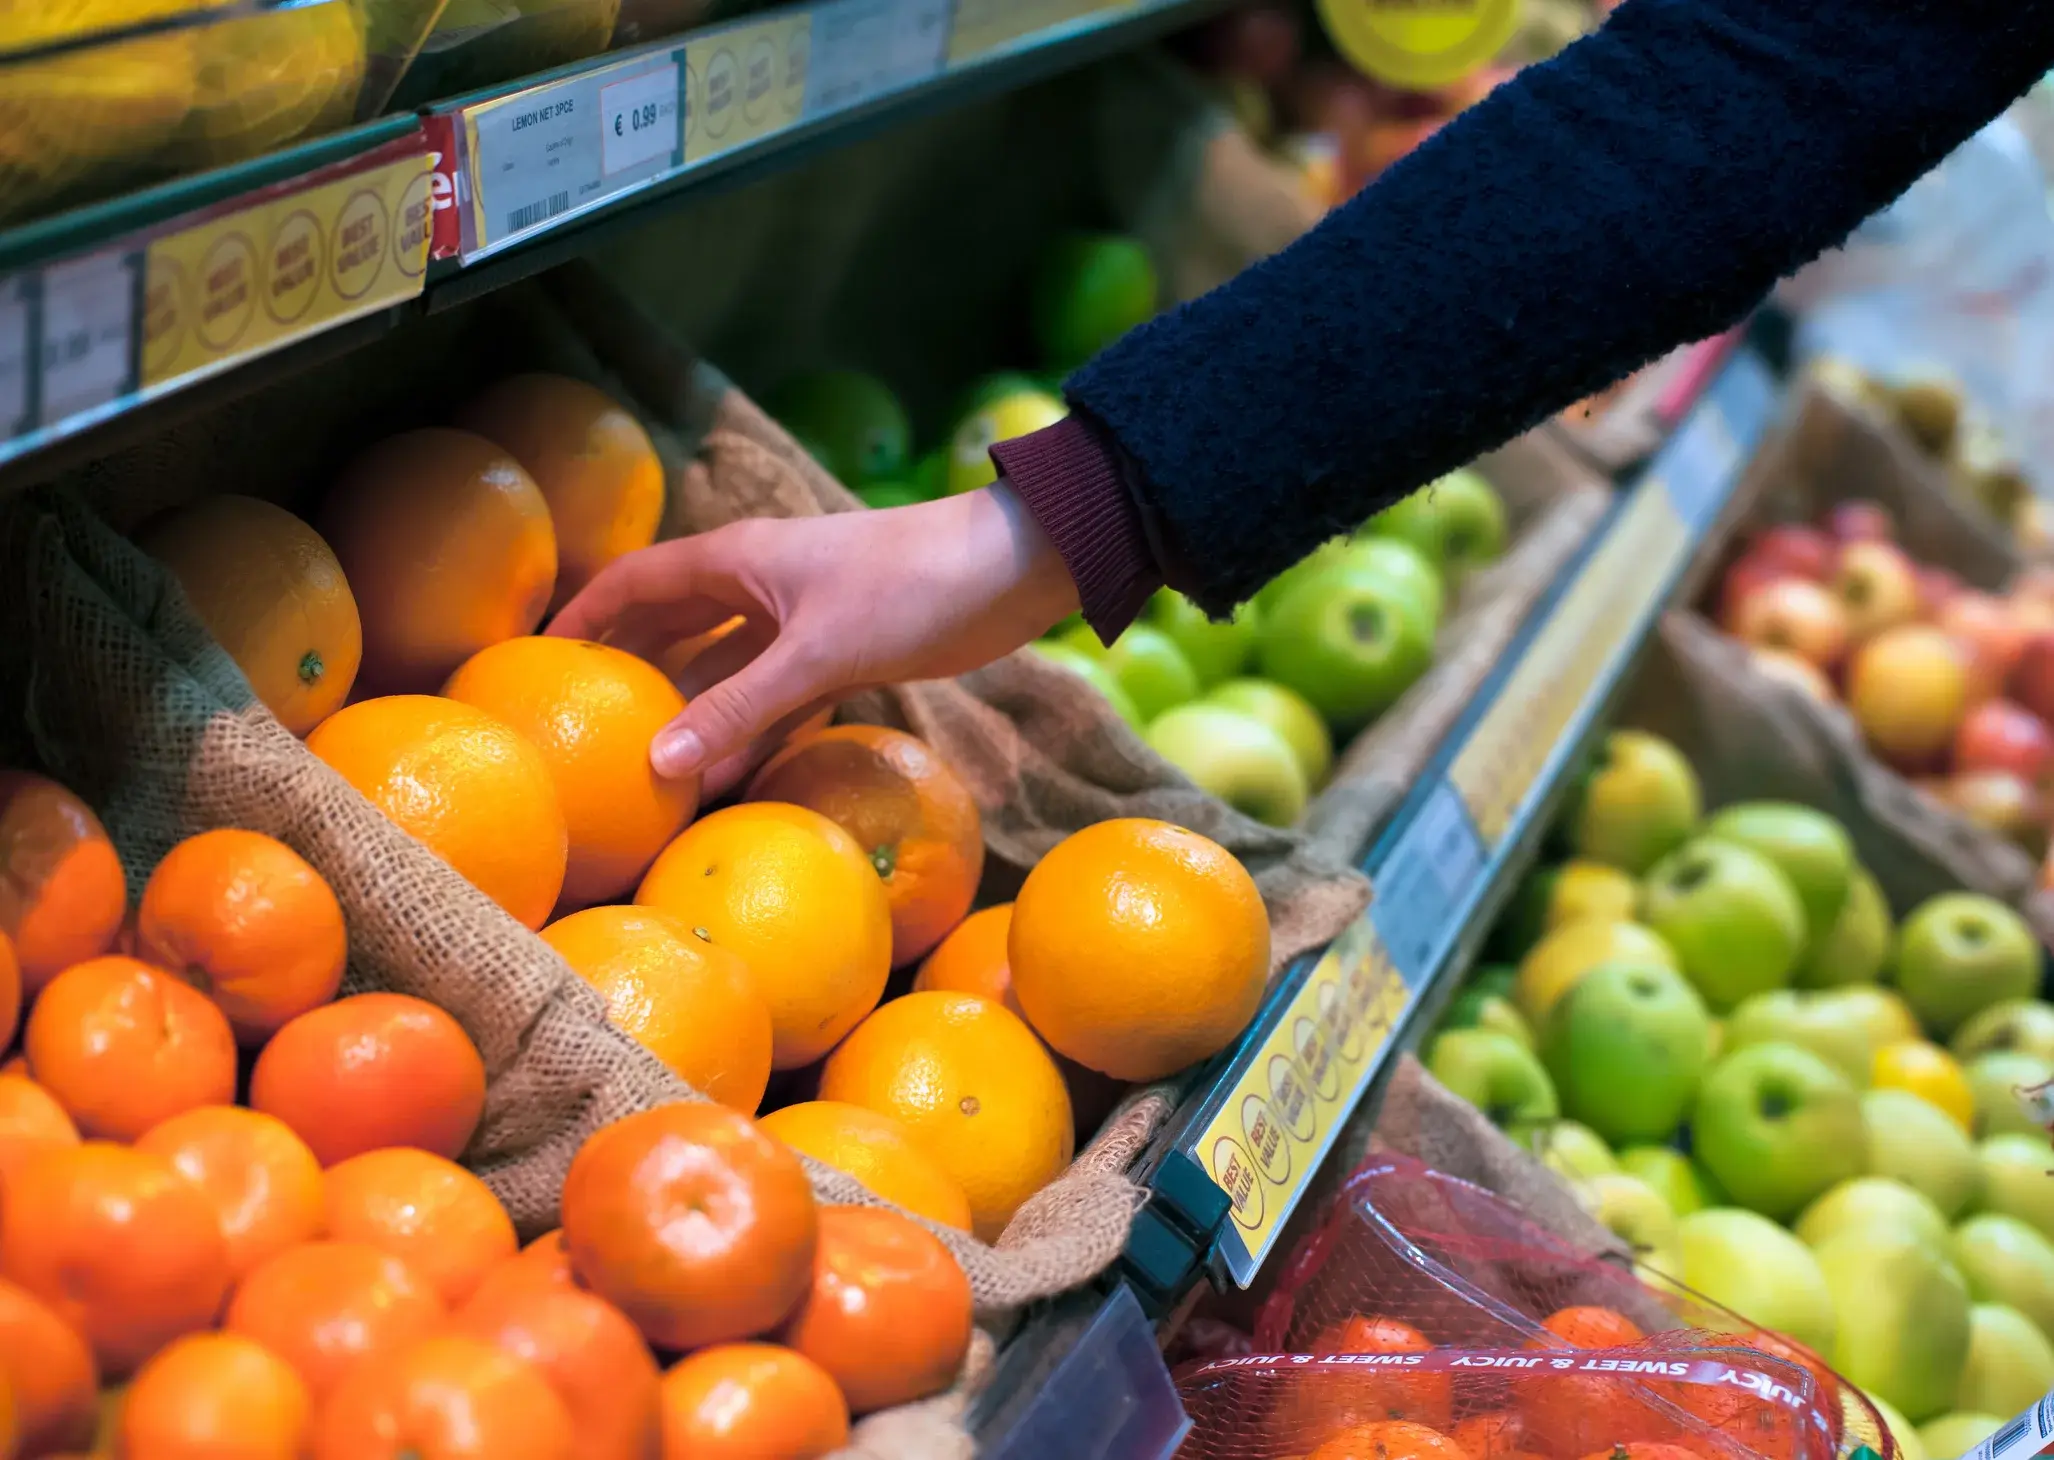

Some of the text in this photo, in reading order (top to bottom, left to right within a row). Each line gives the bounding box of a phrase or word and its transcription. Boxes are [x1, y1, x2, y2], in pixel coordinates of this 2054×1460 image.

[512, 110, 539, 132] LEMON
[539, 105, 554, 123] NET
[614, 113, 623, 137] €
[632, 103, 657, 131] 0.99
[1250, 1109, 1267, 1148] BEST
[1260, 1125, 1280, 1169] VALUE
[1223, 1152, 1241, 1192] BEST
[1232, 1166, 1254, 1214] VALUE
[1196, 1354, 1424, 1373] SWEET & JUICY
[1450, 1356, 1690, 1376] SWEET & JUICY
[1717, 1369, 1807, 1408] JUICY
